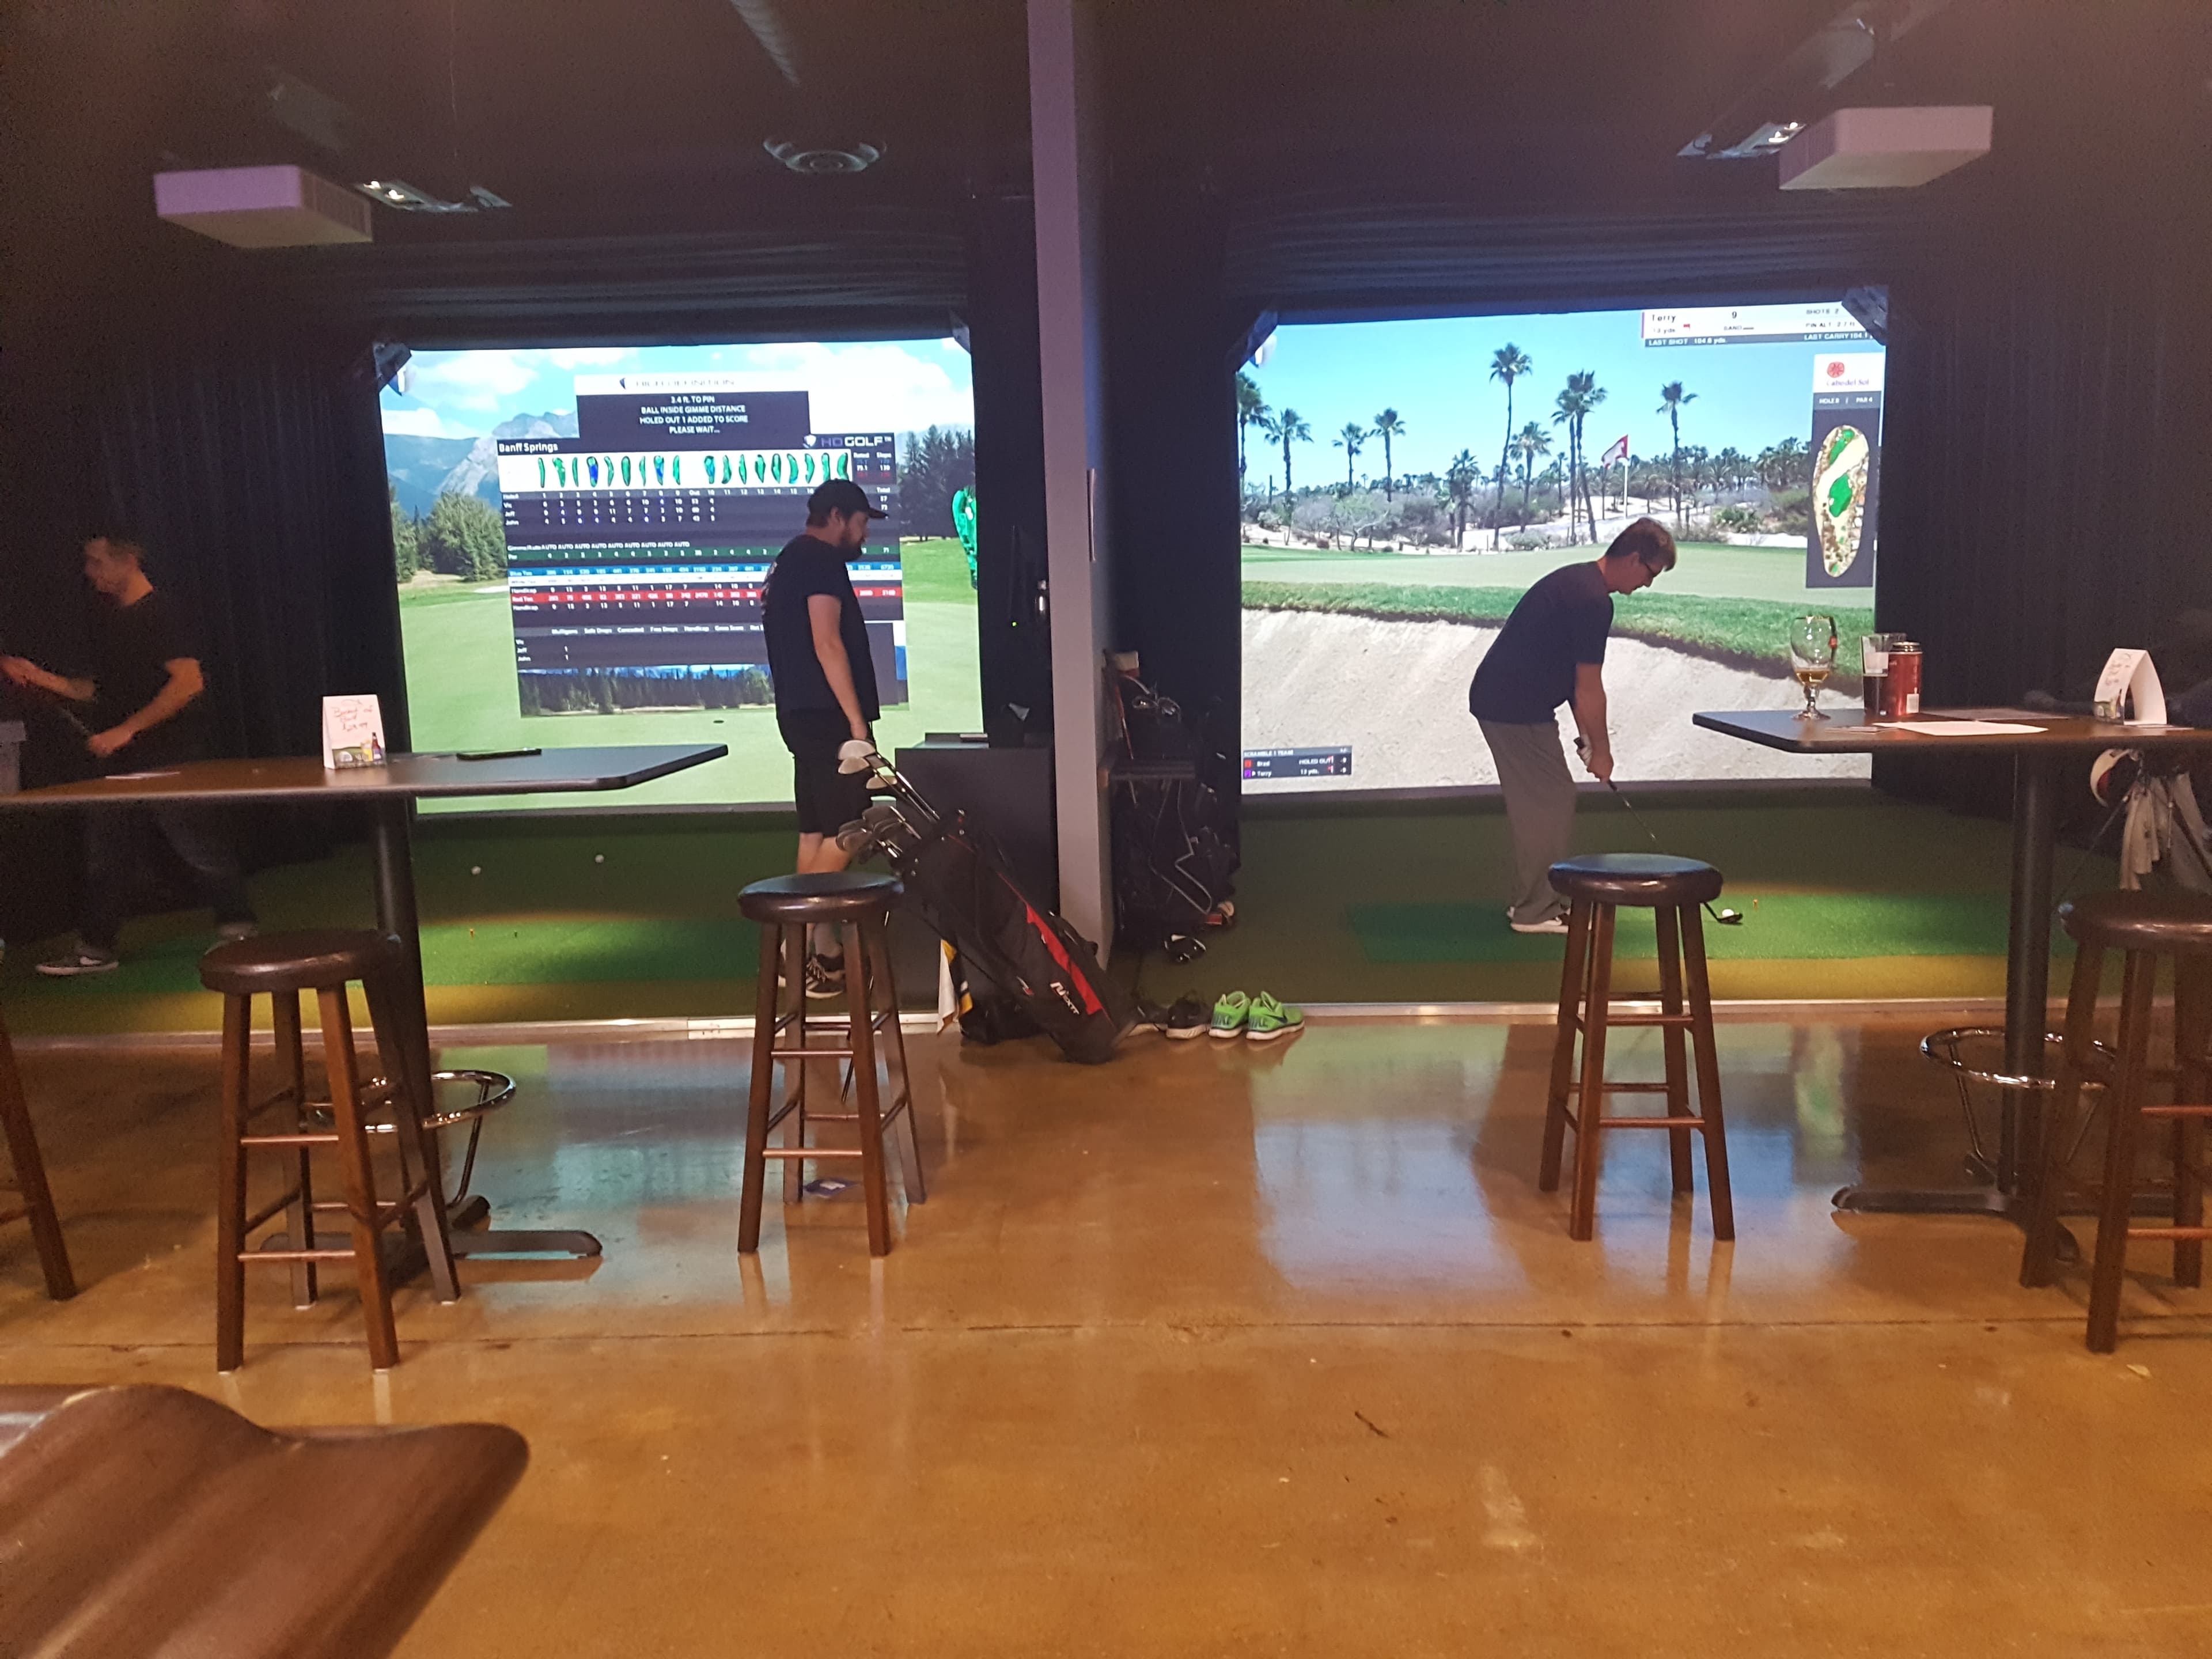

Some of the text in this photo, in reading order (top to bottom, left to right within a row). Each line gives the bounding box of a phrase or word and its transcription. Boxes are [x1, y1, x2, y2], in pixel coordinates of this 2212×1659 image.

[660, 406, 684, 414] INSIDE
[684, 406, 710, 414] GIMME
[710, 404, 746, 413] DISTANCE
[639, 416, 664, 425] HOLED
[665, 416, 680, 424] OUT
[687, 415, 713, 423] ADDED
[714, 415, 725, 423] TO
[725, 415, 748, 423] SCORE
[669, 426, 695, 434] PLEASE
[498, 442, 559, 454] Banff Springs
